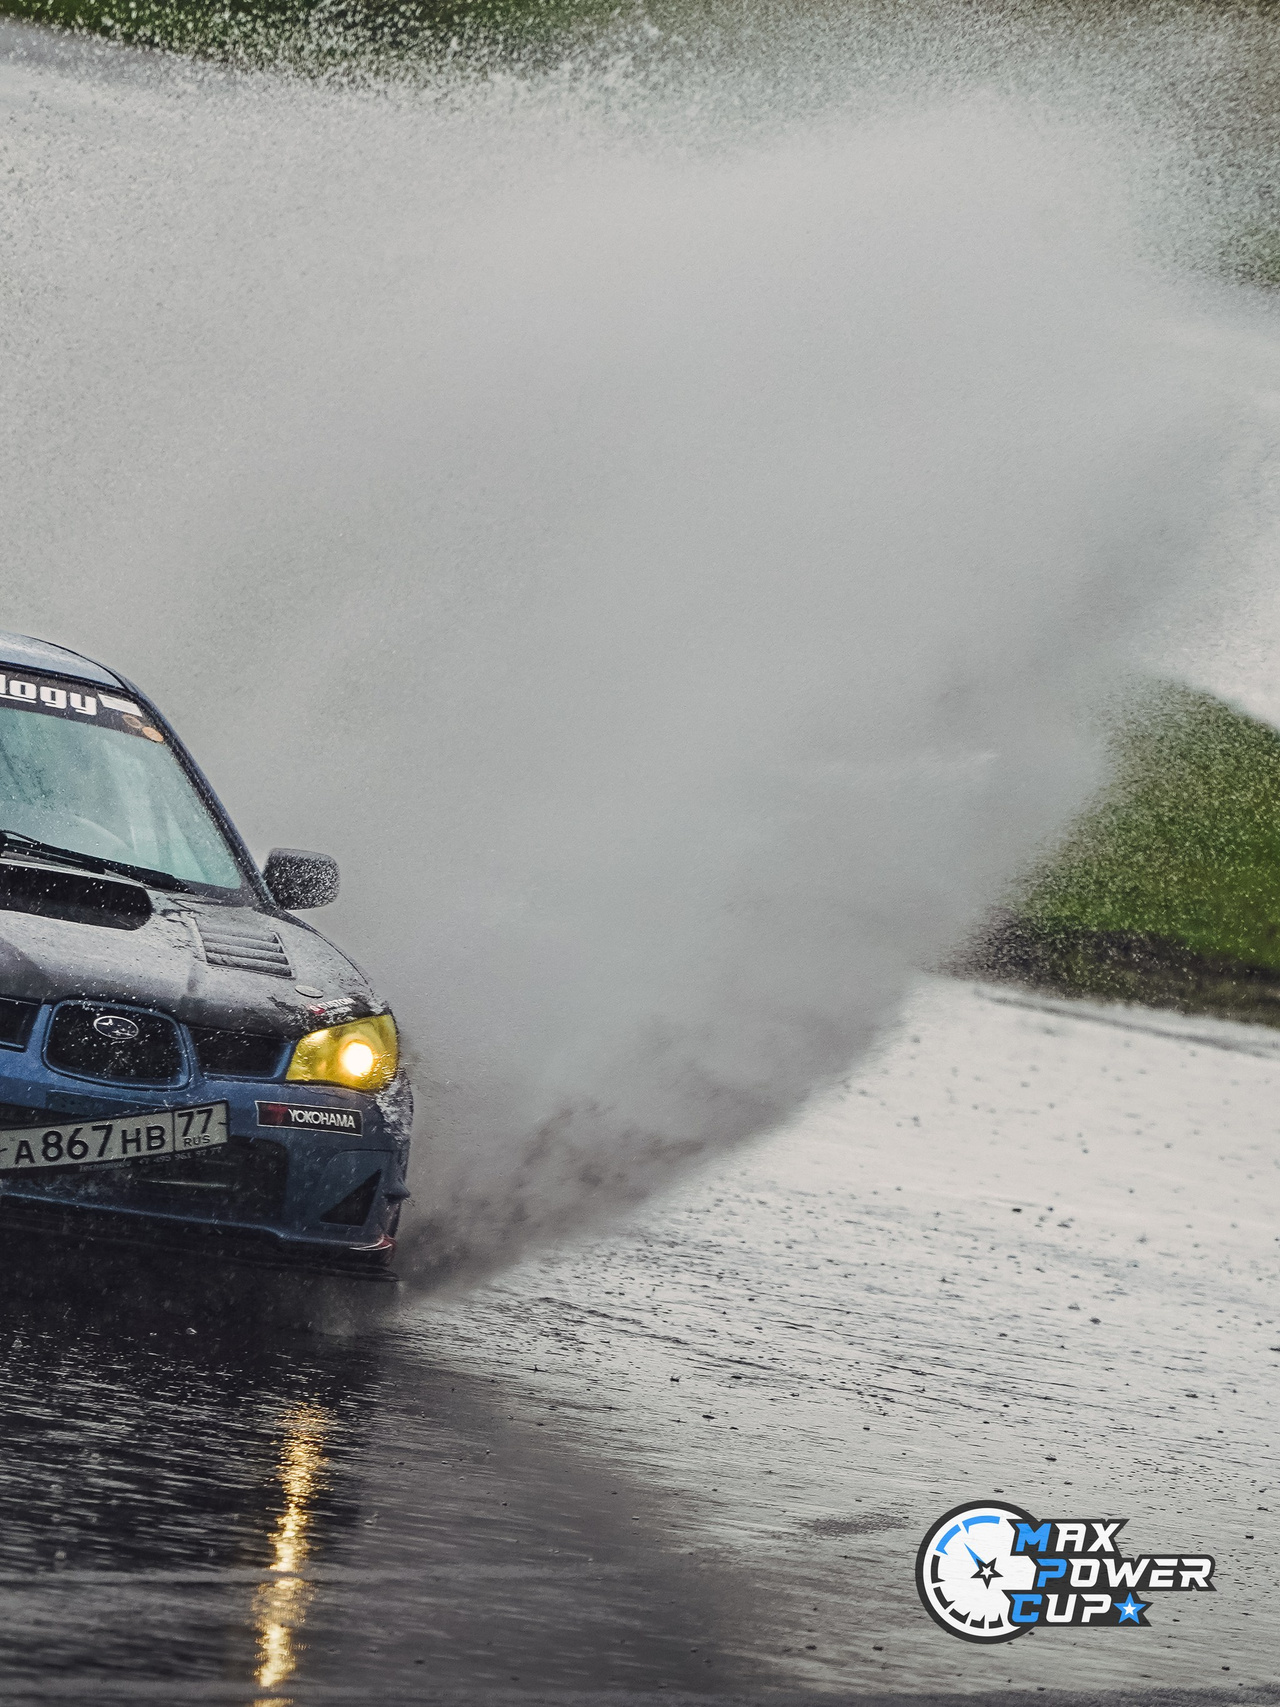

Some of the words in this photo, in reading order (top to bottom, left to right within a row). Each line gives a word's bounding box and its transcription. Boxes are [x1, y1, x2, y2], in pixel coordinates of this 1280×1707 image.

[177, 1107, 214, 1137] 77
[287, 1107, 356, 1129] YOKOHAMA
[183, 1135, 211, 1148] RUS
